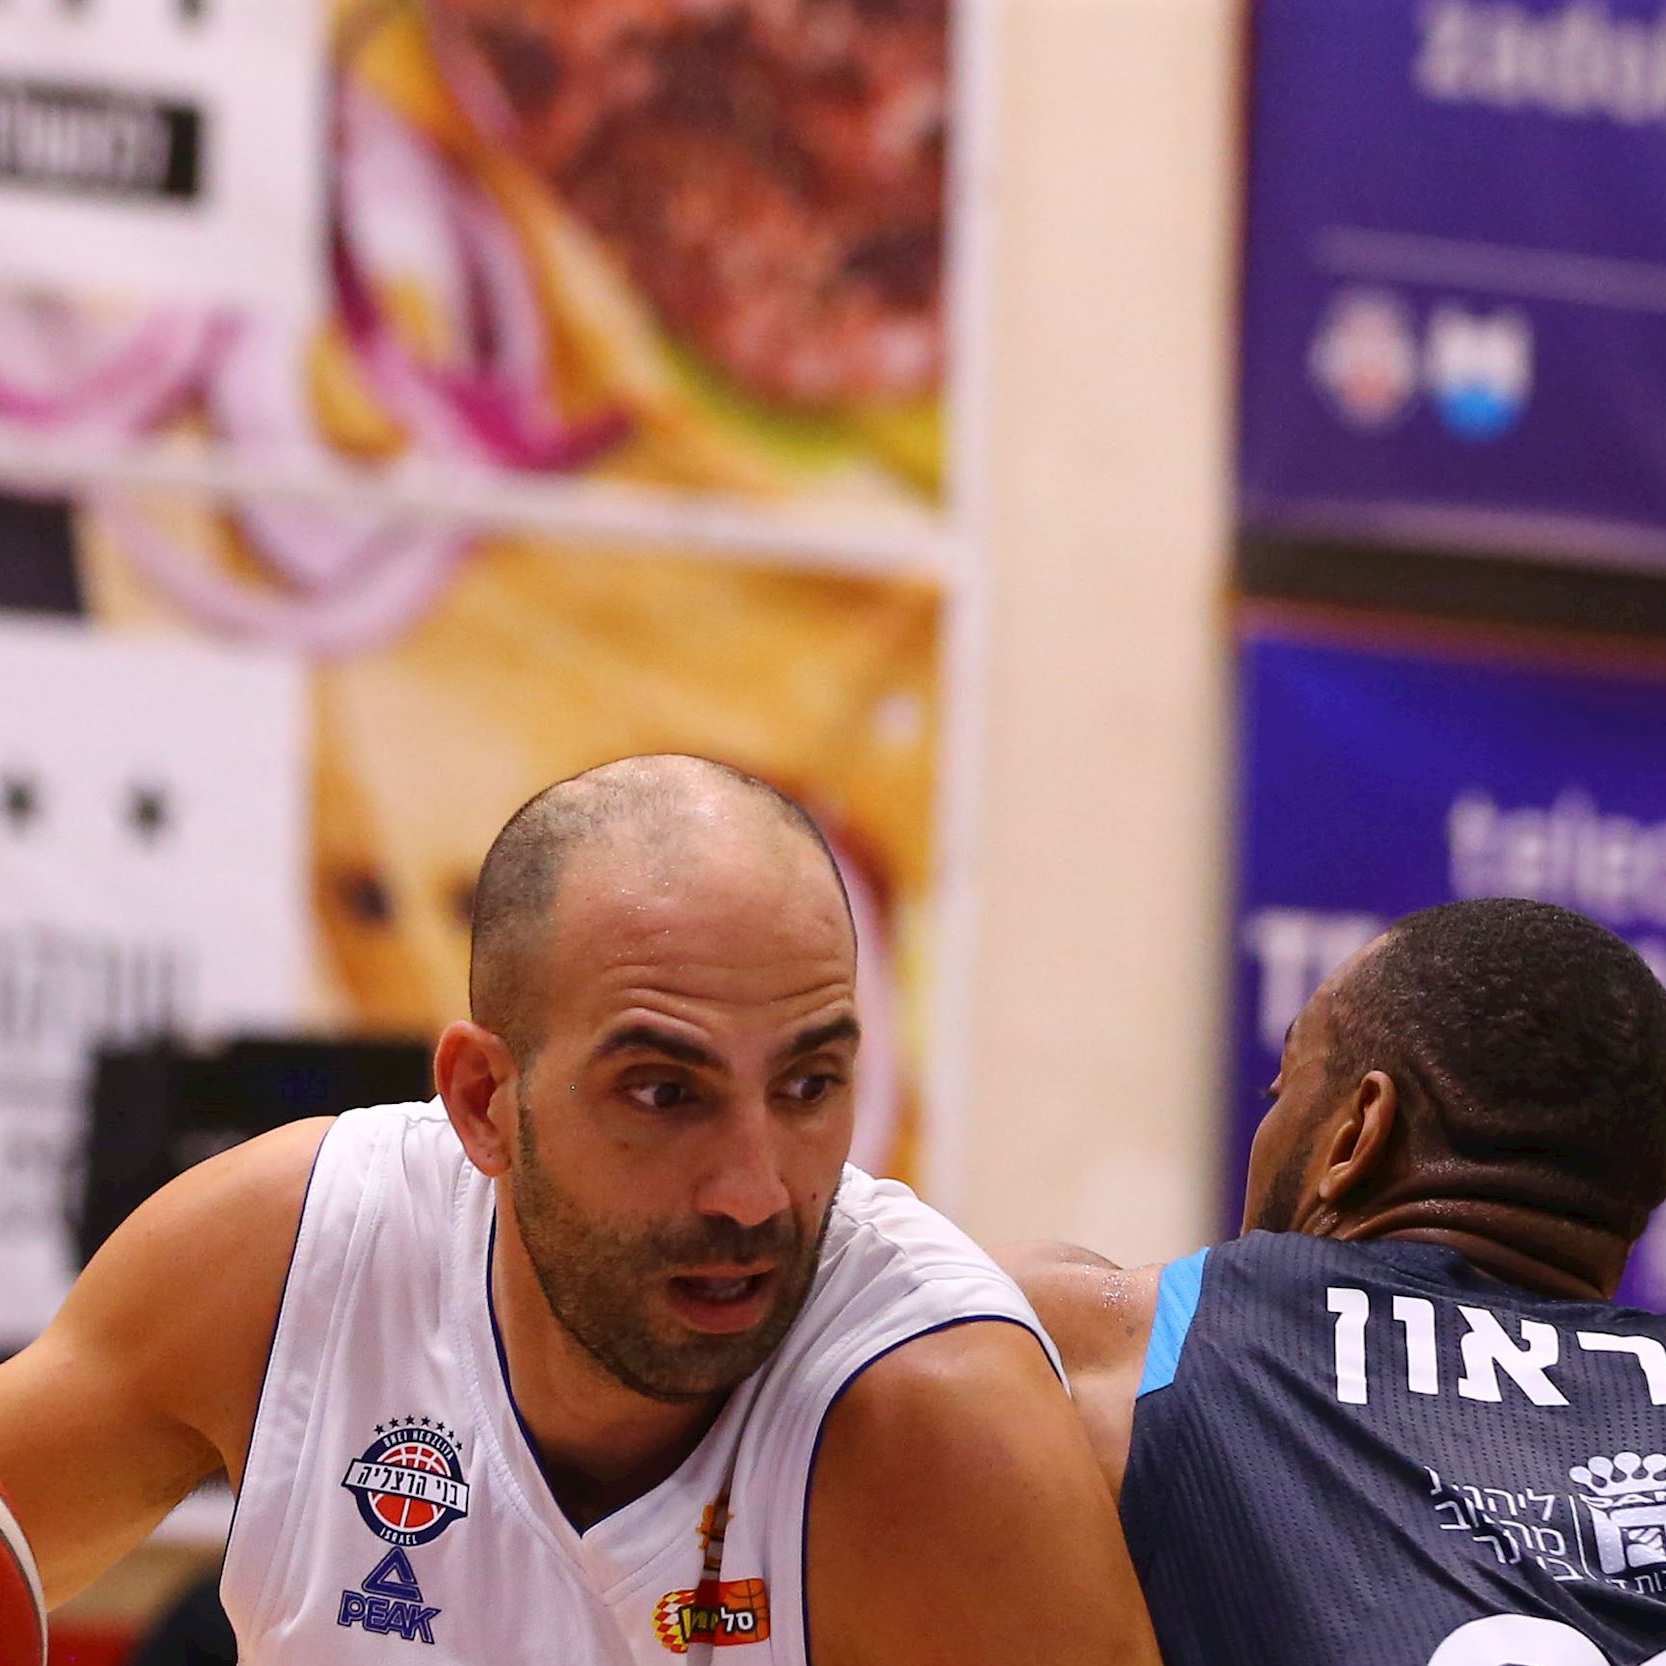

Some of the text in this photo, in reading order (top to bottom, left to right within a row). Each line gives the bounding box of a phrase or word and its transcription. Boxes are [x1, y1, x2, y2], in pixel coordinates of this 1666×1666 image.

[382, 1430, 455, 1461] BNEI HERZLIYA
[356, 1465, 459, 1506] בני הרצליה
[379, 1526, 418, 1545] ISRAEL
[336, 1589, 443, 1646] PEAK
[720, 1606, 754, 1633] סל
